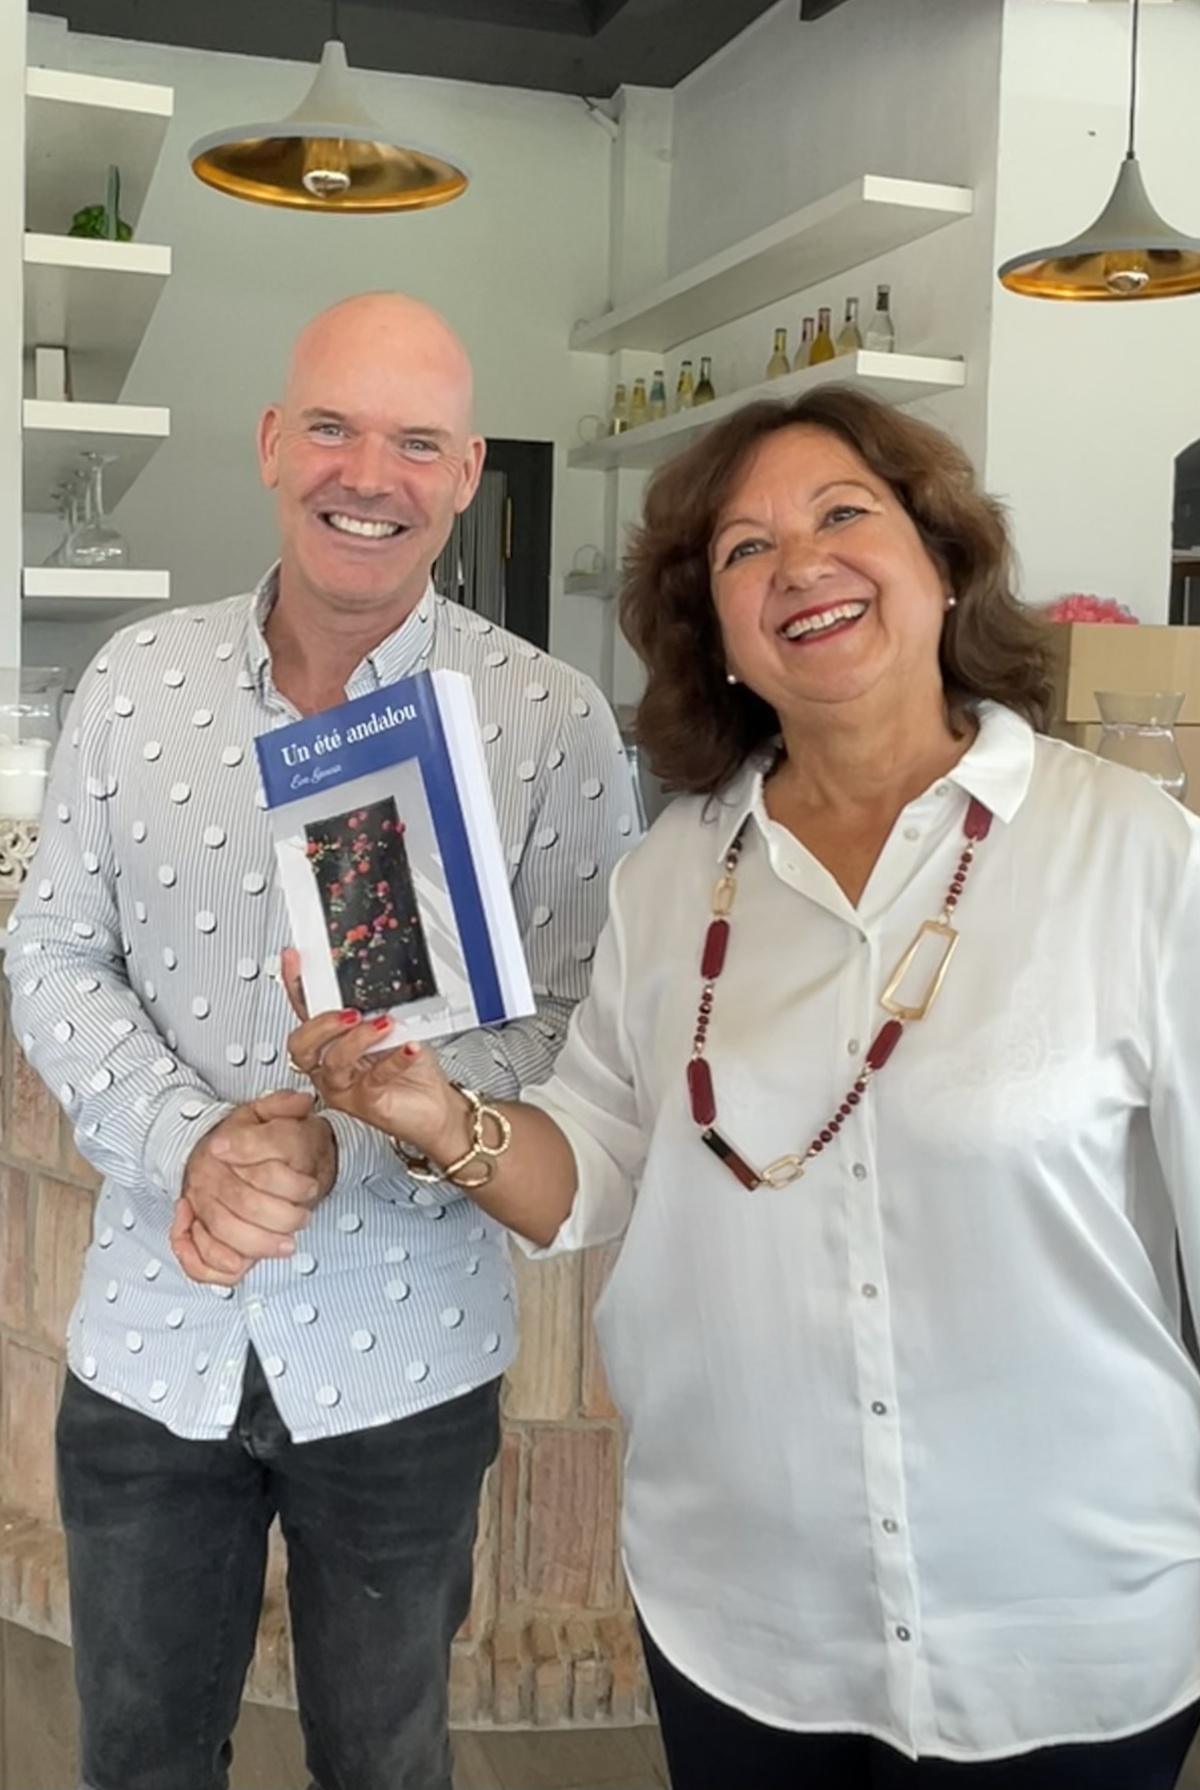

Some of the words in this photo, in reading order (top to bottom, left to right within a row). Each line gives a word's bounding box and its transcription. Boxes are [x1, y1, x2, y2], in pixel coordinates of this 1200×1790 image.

[281, 743, 310, 766] Un
[314, 728, 343, 755] été
[346, 704, 417, 743] andalou
